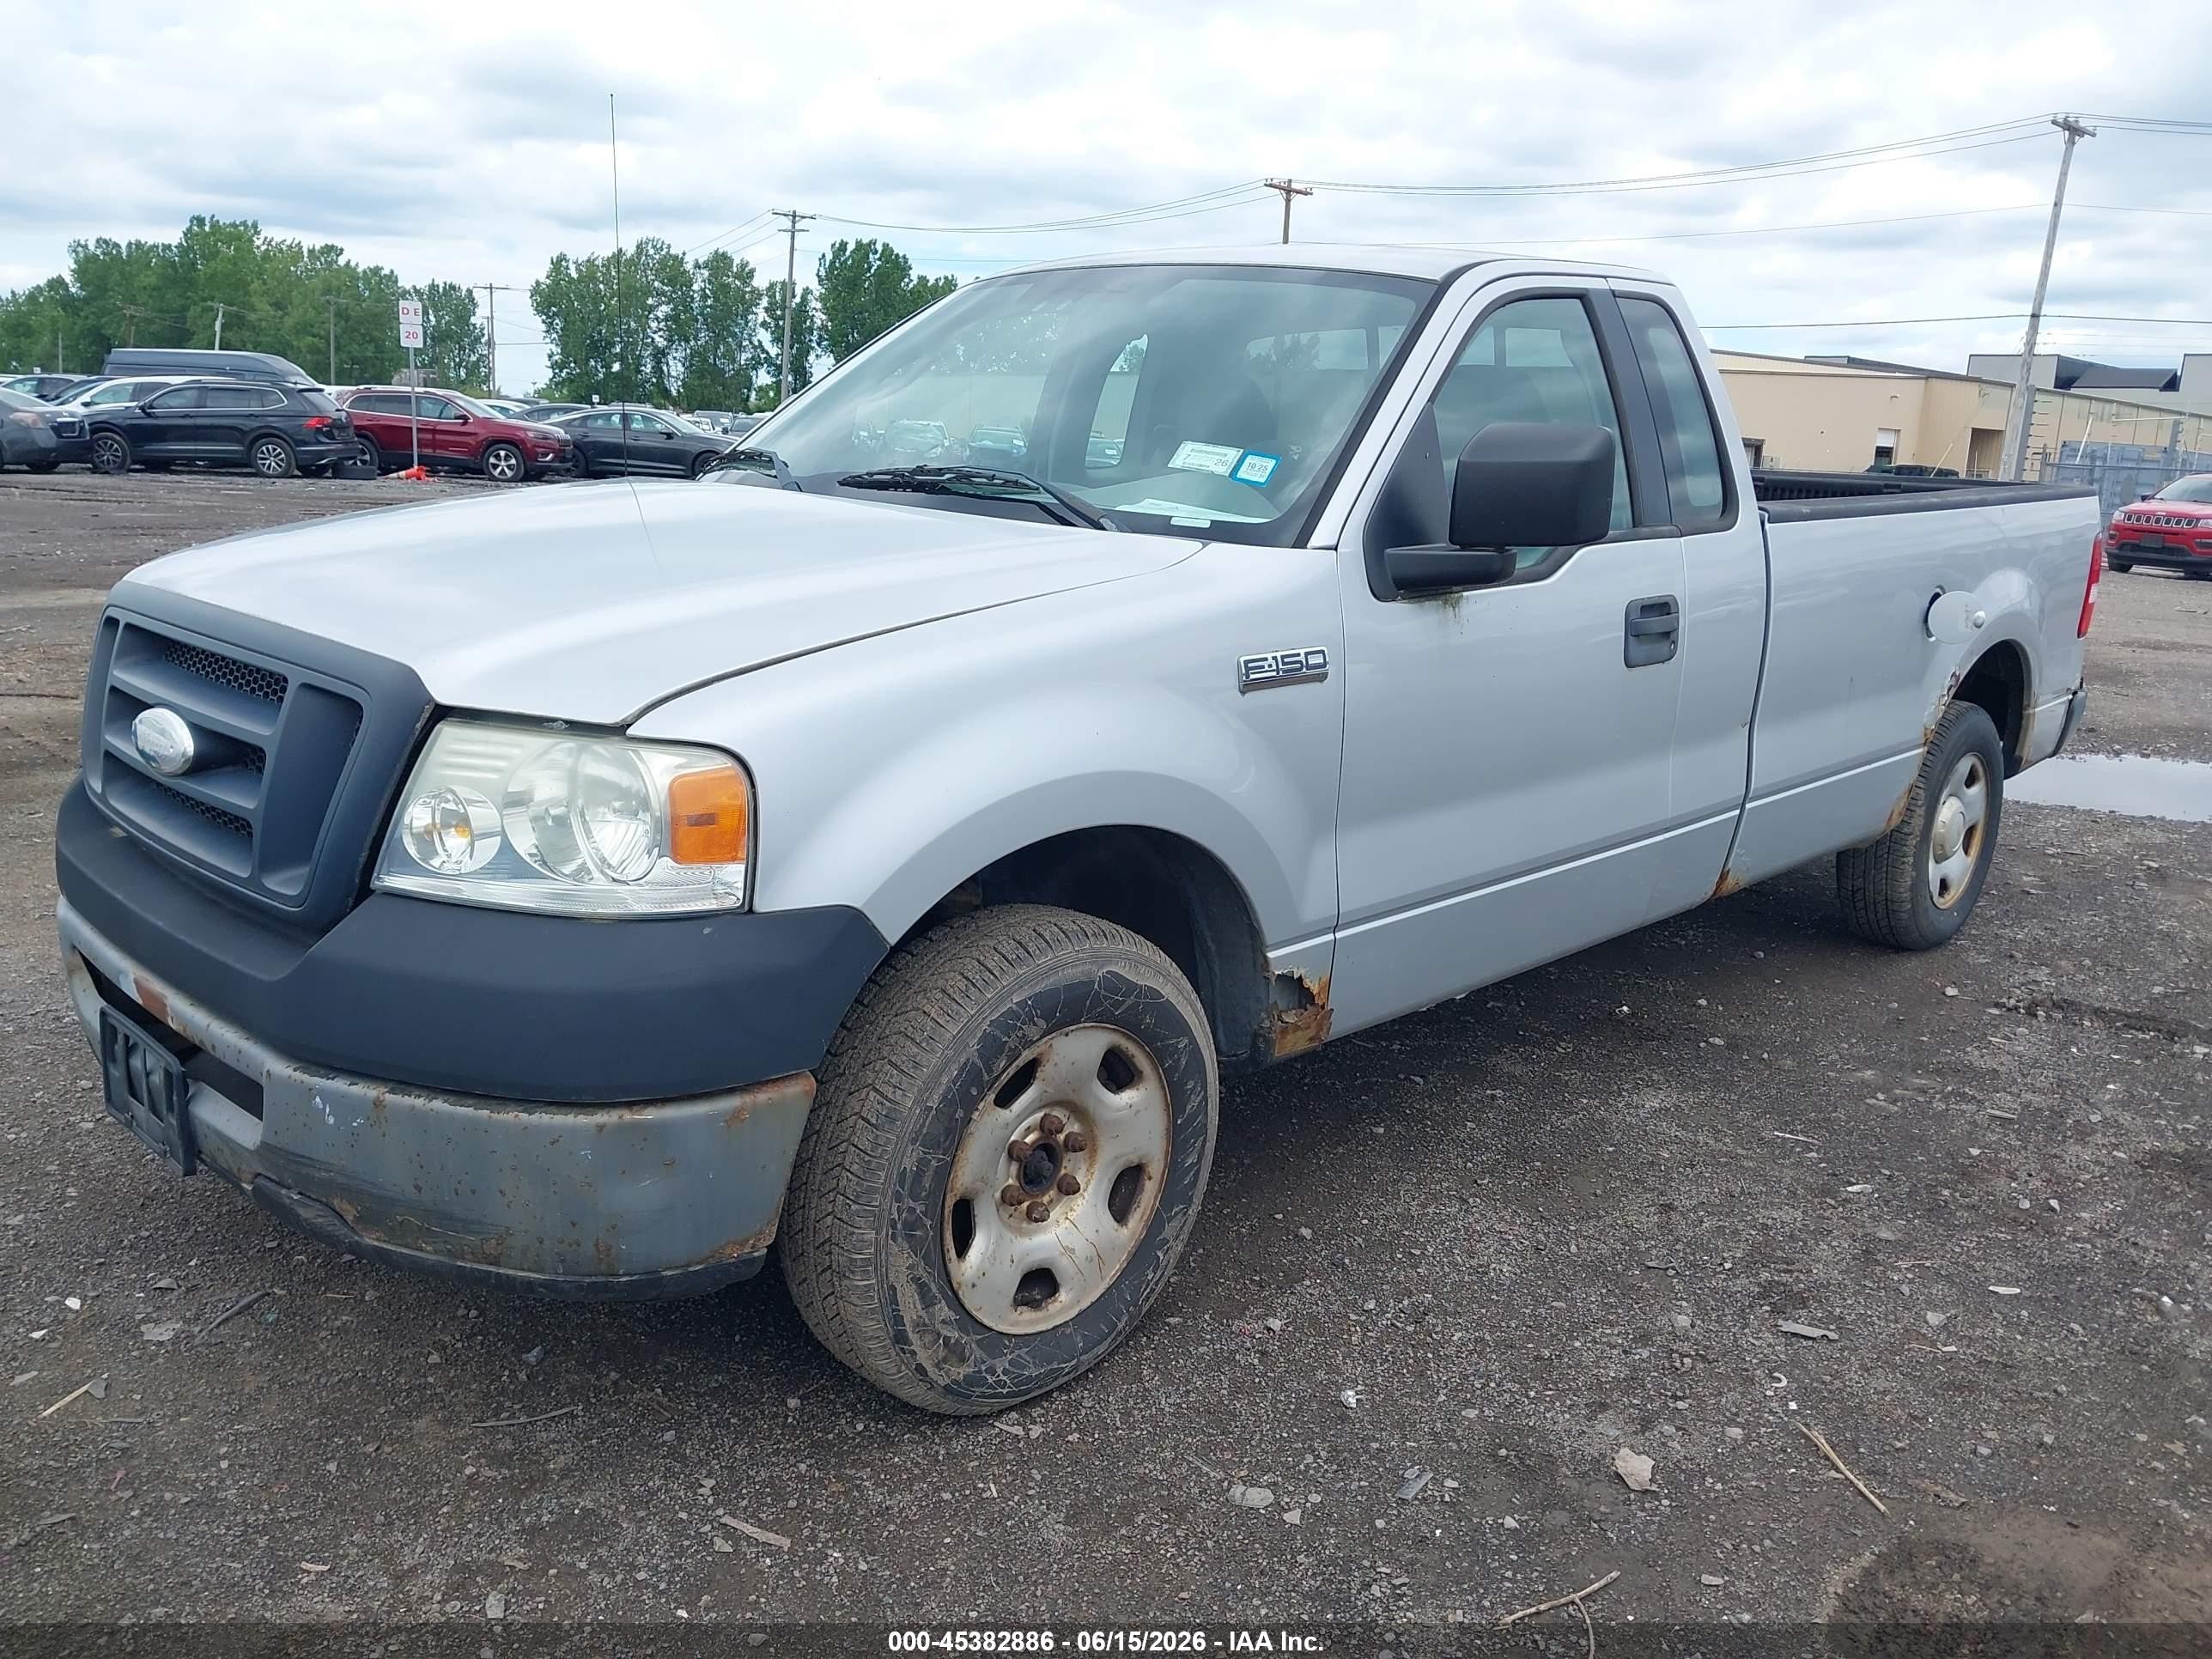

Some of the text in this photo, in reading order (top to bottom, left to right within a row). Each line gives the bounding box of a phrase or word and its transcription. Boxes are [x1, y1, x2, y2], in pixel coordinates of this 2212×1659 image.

[405, 331, 418, 339] 20
[1214, 459, 1230, 467] 26
[1243, 648, 1328, 680] F-150
